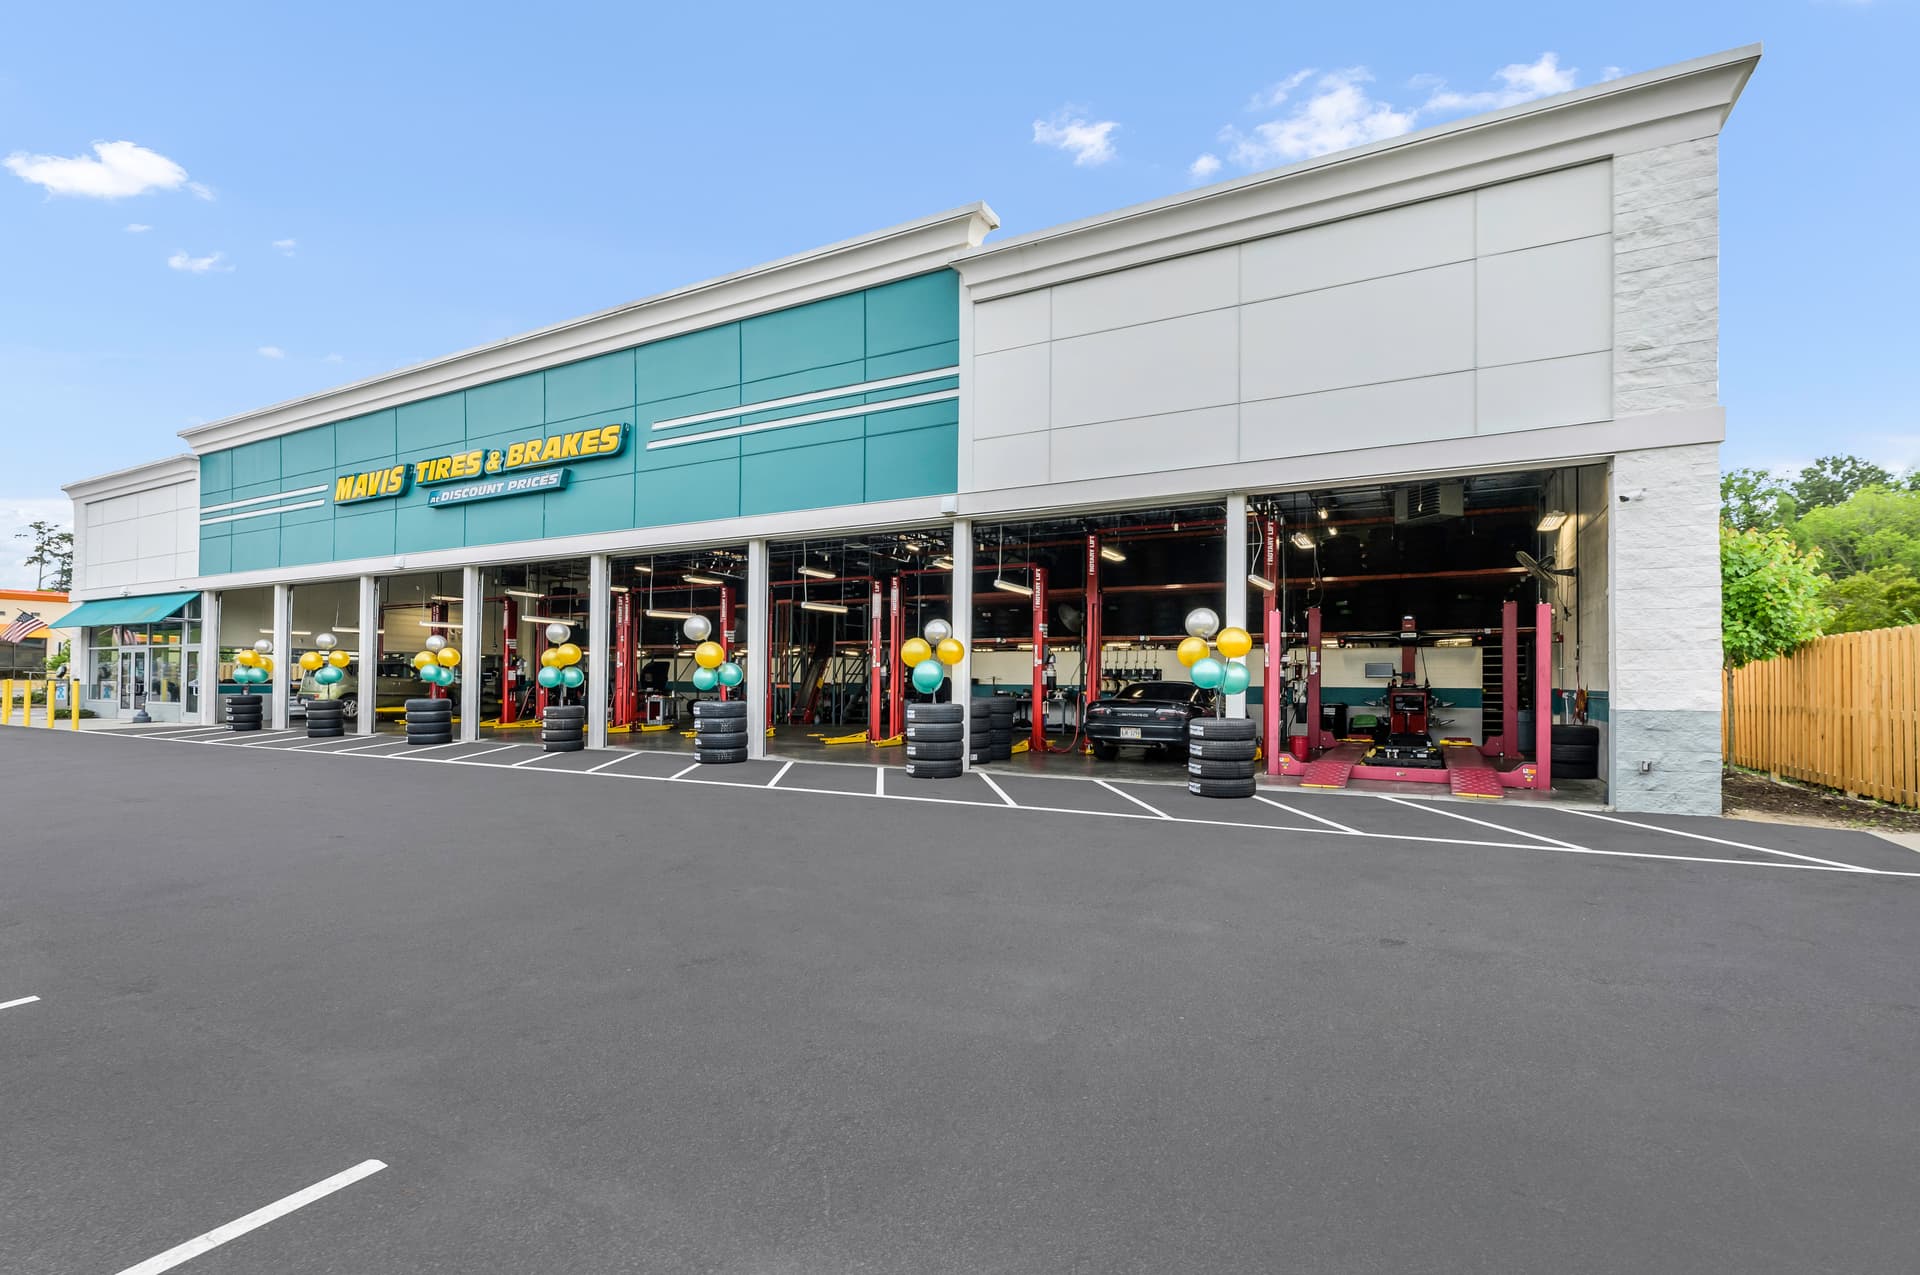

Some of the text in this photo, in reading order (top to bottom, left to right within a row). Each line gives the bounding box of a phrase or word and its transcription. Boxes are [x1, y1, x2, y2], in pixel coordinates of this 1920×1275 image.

[334, 424, 621, 502] MAVIS TIRES & BRAKES
[441, 482, 505, 502] DISCOUNT
[507, 473, 559, 491] PRICES
